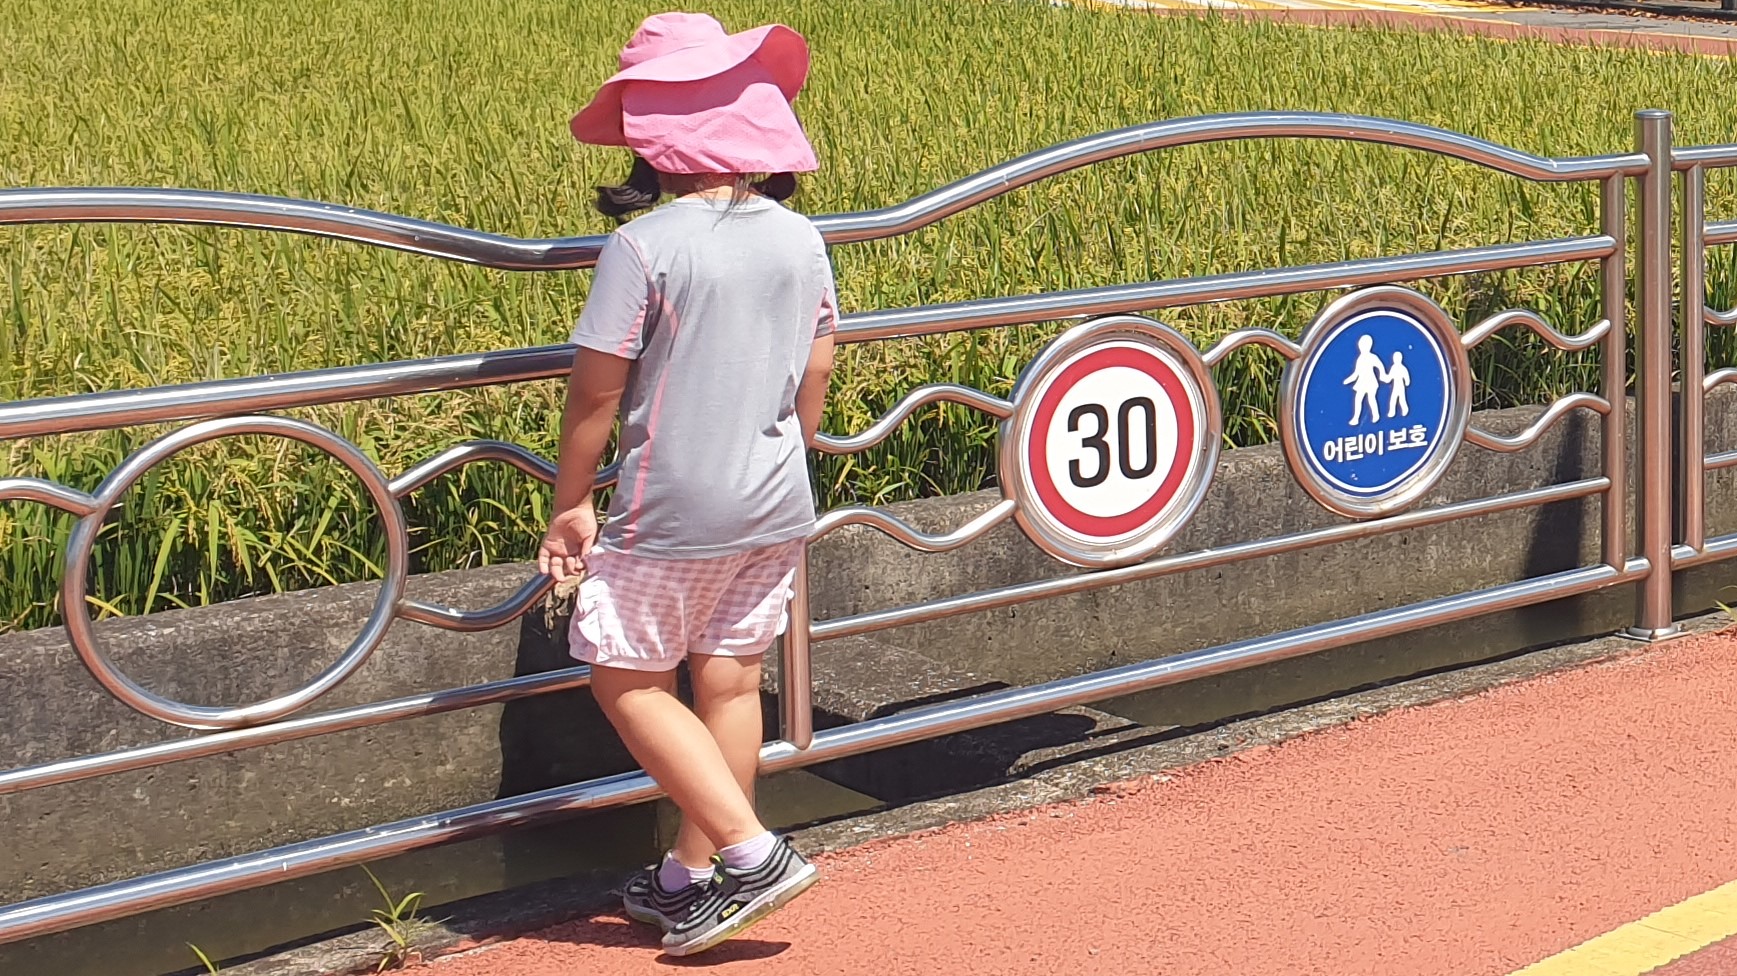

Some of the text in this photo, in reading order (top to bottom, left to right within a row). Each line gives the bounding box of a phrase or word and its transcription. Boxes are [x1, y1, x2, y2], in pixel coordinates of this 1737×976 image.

[1067, 396, 1158, 489] 30
[1323, 425, 1428, 463] 어린이 보호
